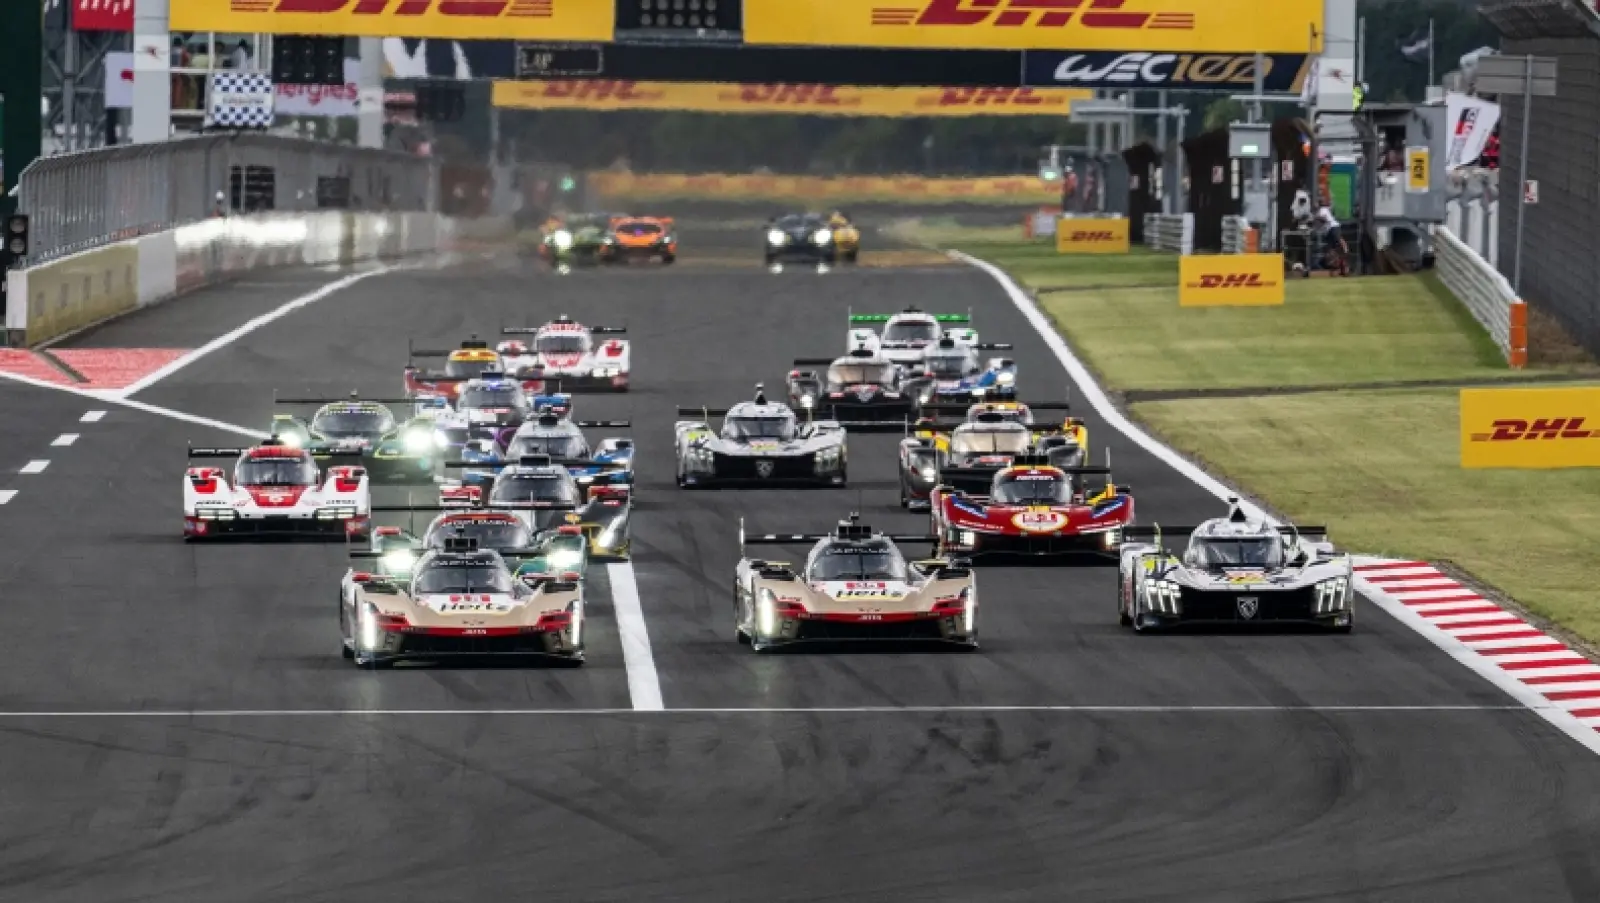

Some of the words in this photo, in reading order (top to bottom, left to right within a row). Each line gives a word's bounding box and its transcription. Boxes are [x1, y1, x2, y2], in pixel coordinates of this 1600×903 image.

[1071, 230, 1114, 242] DHL
[1199, 273, 1264, 288] DHL
[1490, 417, 1591, 440] DHL
